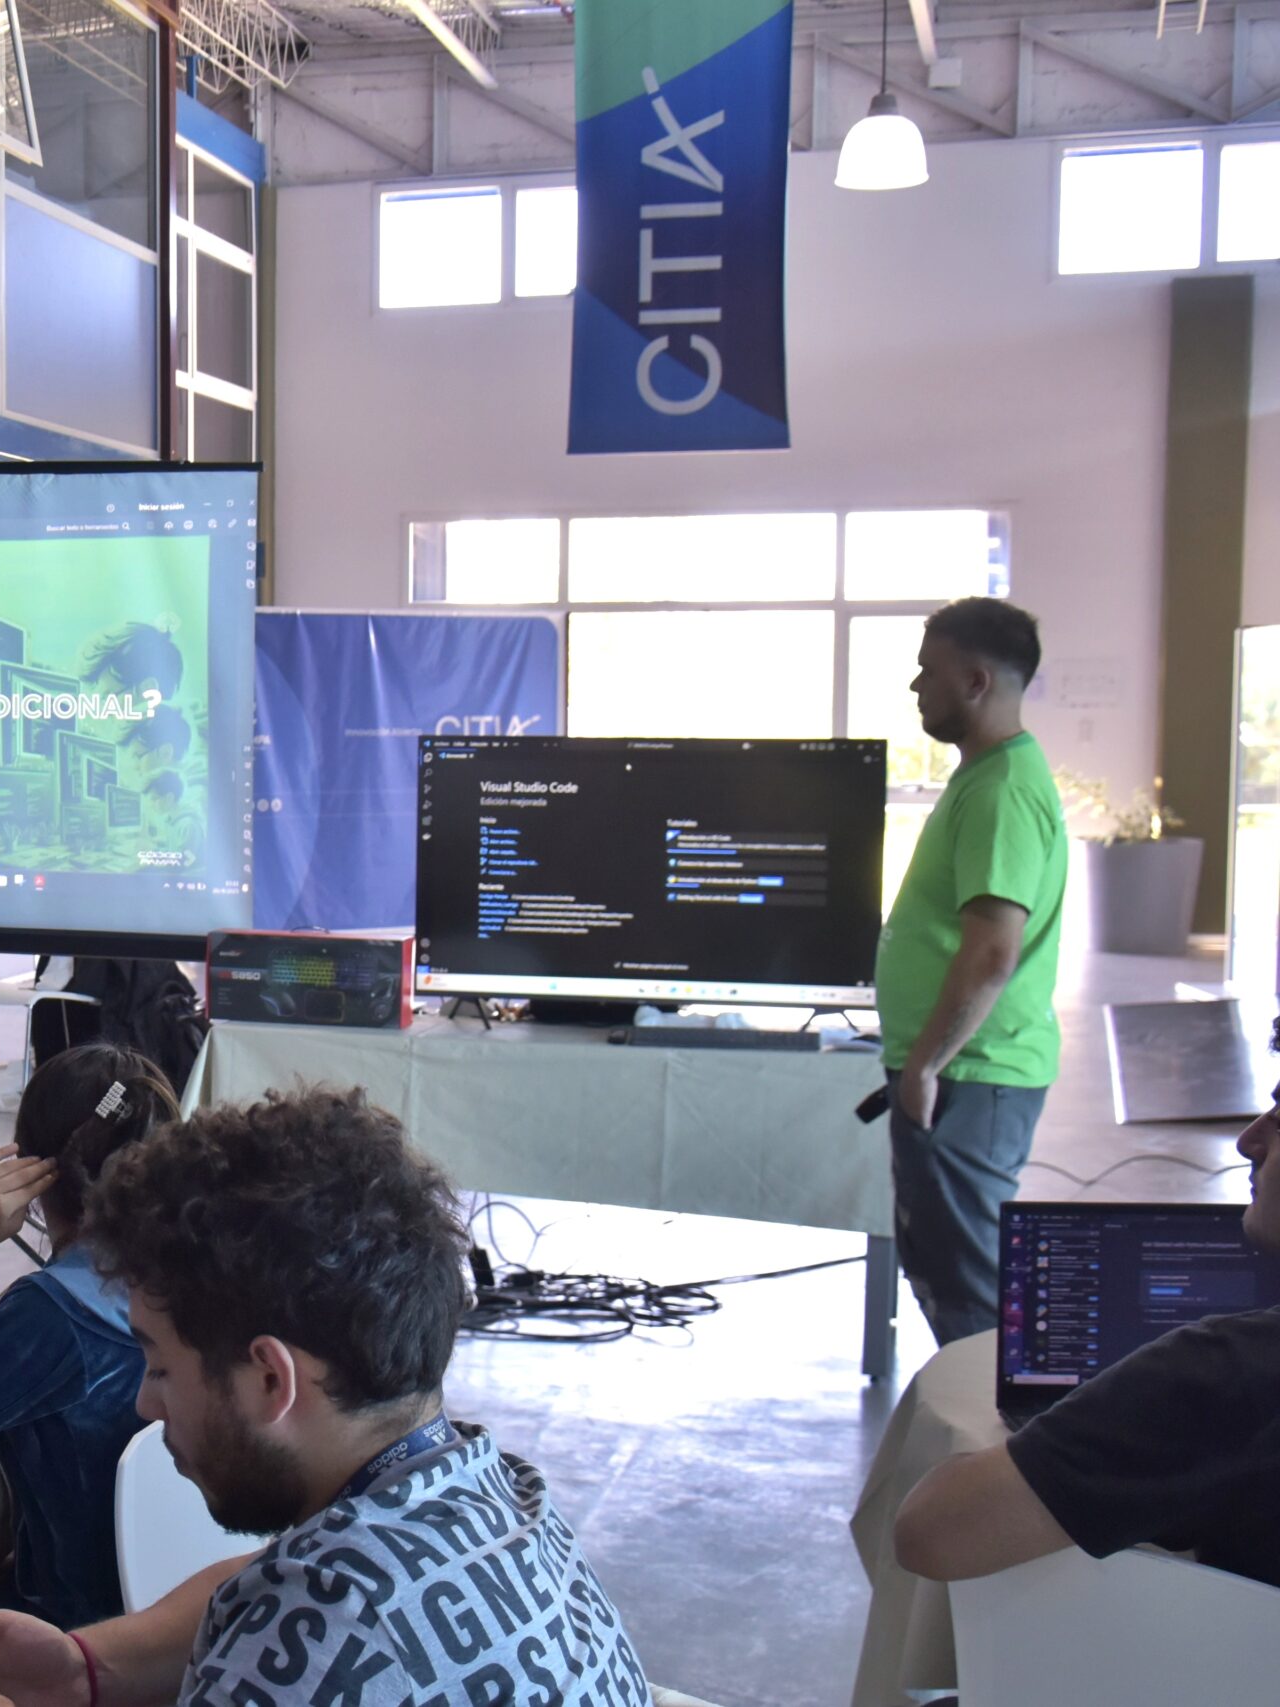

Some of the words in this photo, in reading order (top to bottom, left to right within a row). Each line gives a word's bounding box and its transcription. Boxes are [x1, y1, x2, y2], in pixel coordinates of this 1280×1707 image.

[480, 781, 512, 792] Visual
[513, 781, 548, 793] Studio
[549, 782, 579, 794] Code
[480, 797, 509, 806] Edición
[510, 798, 548, 808] mejorada
